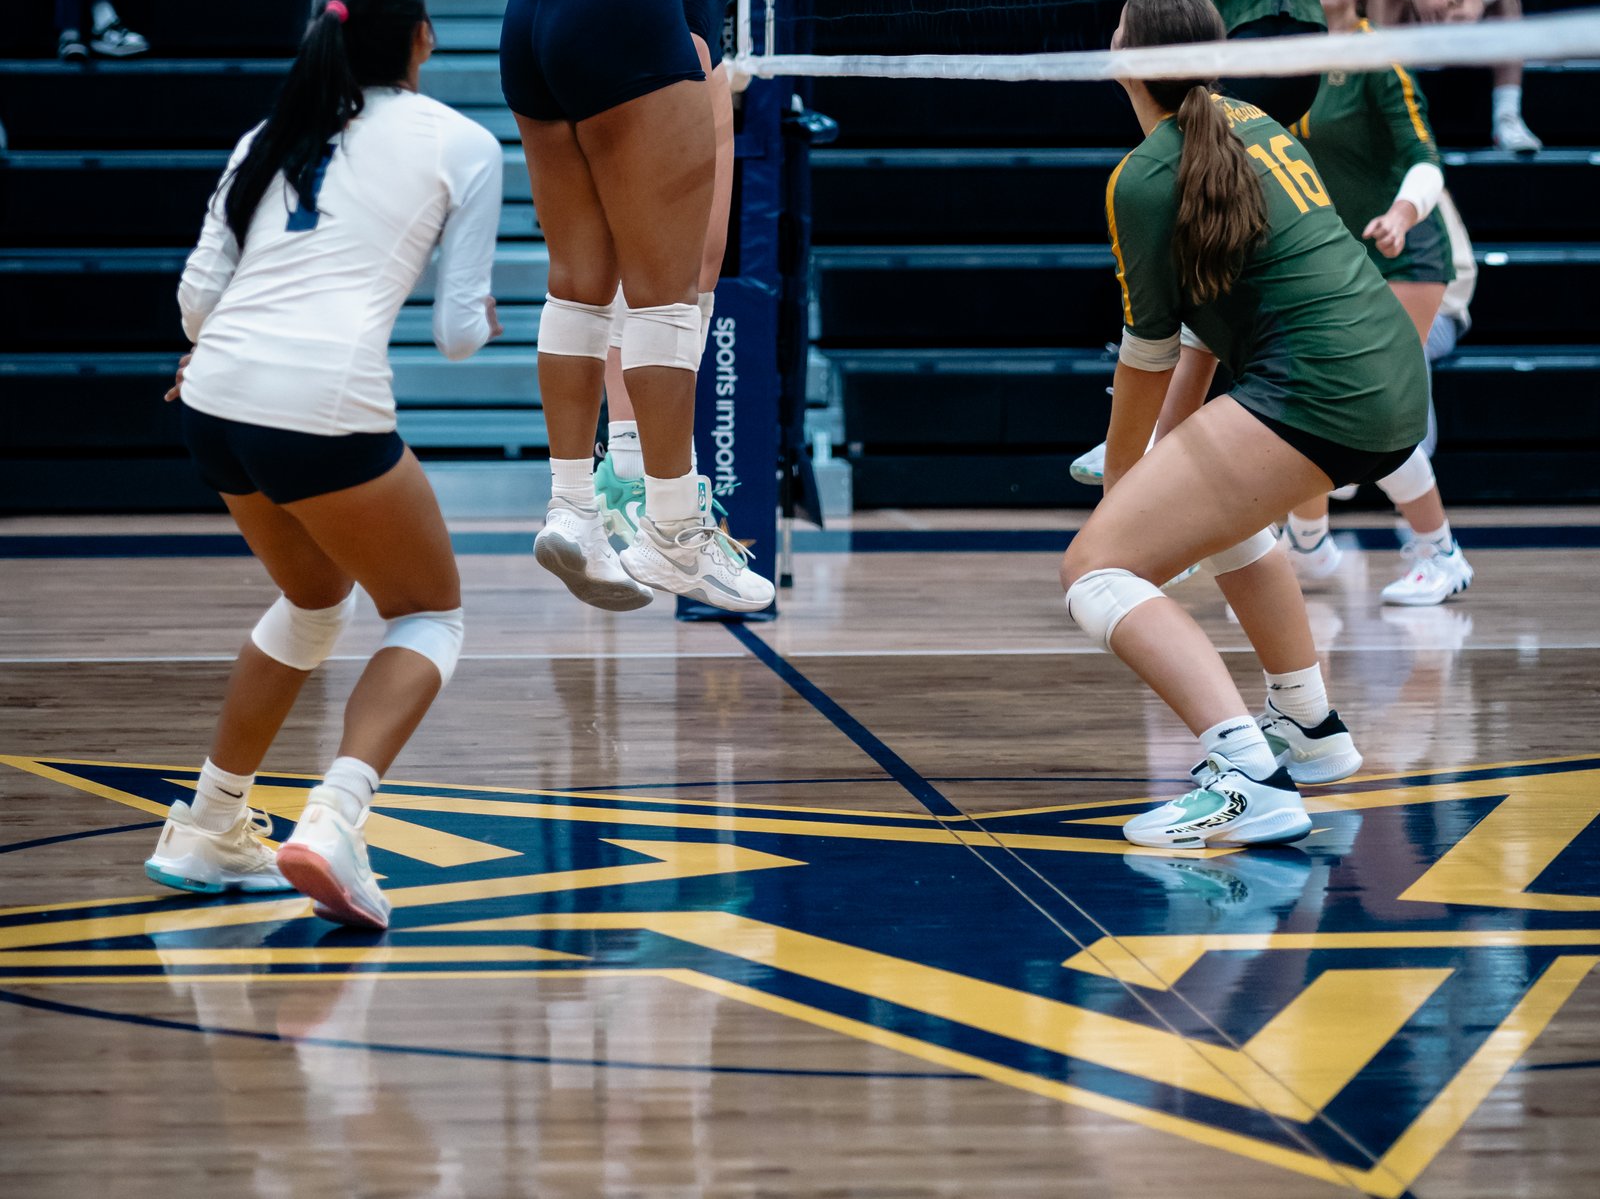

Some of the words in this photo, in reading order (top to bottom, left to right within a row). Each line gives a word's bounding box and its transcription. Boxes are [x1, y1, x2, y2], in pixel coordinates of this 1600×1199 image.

[1246, 134, 1331, 214] 16
[711, 316, 739, 397] sports
[711, 400, 738, 497] imports
